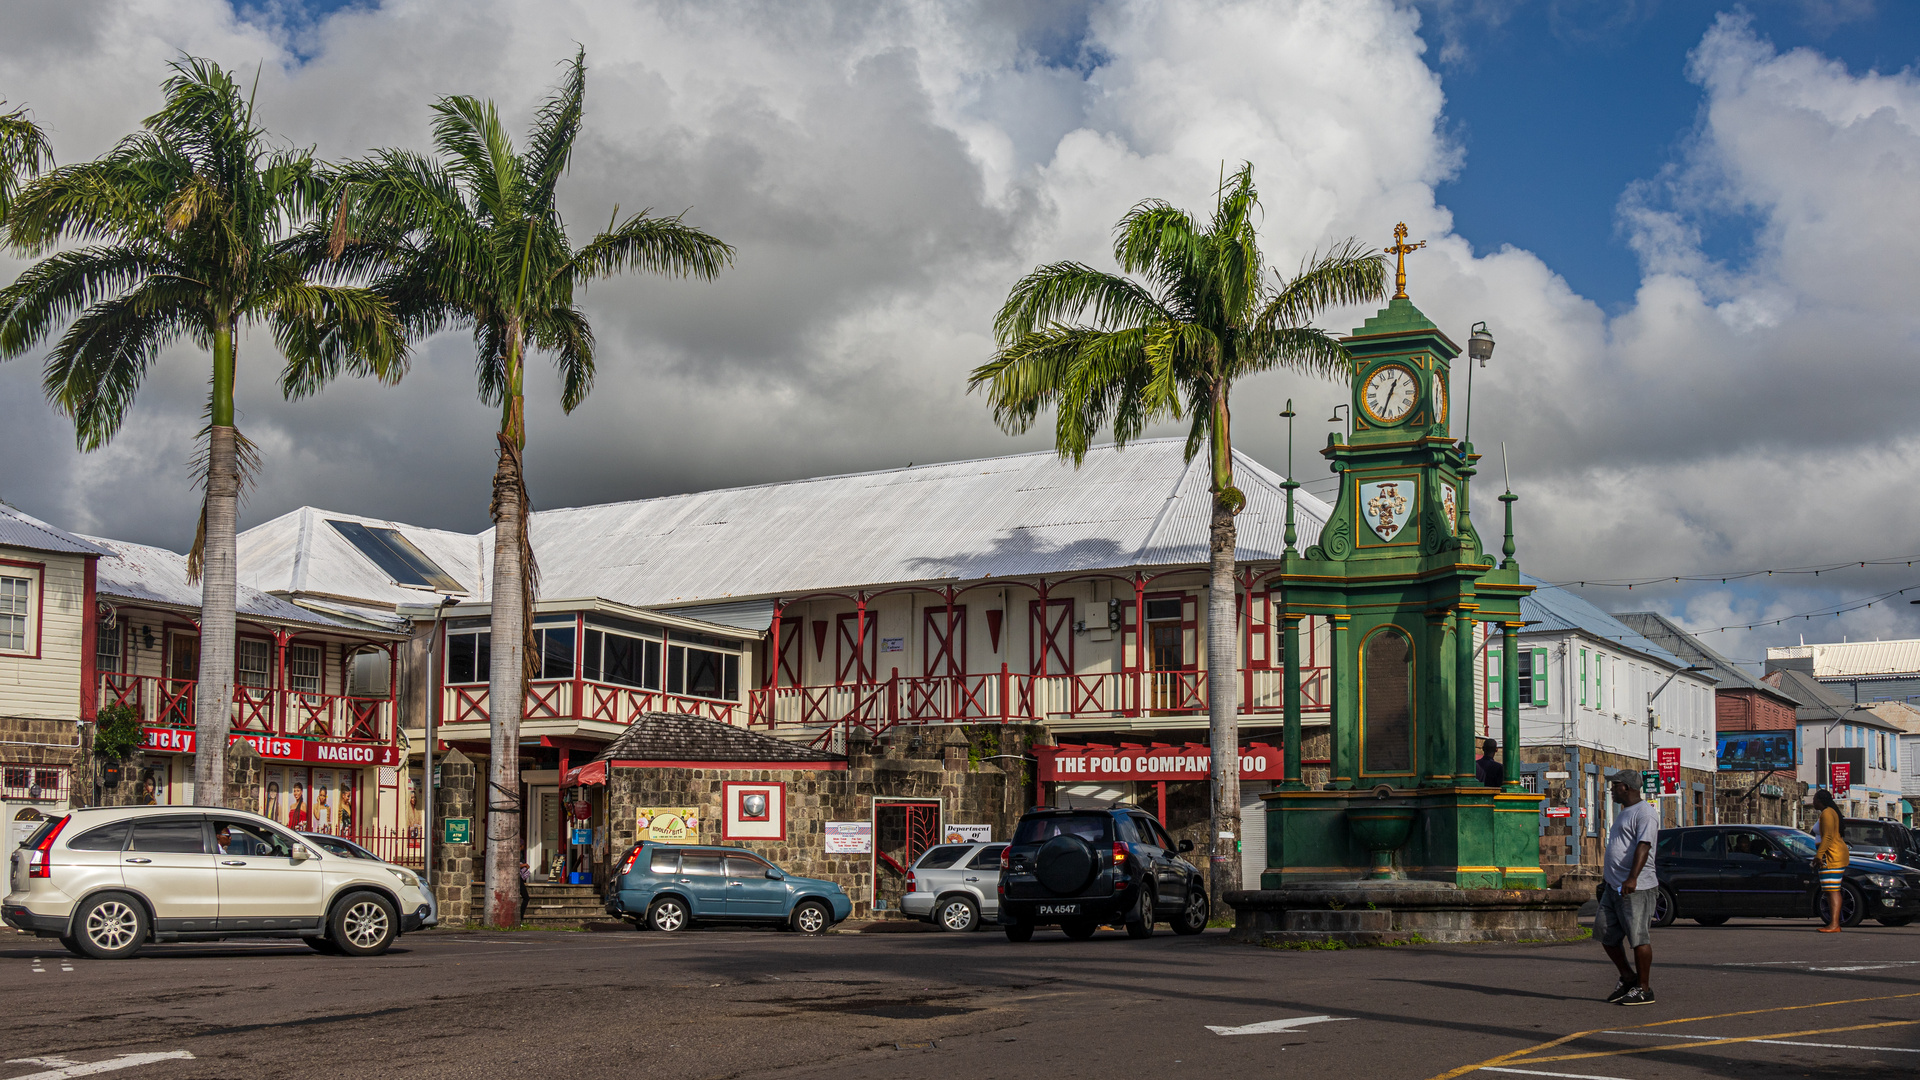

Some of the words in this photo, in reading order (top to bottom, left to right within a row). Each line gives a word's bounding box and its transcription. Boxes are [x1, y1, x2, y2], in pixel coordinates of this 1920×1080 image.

[138, 729, 192, 753] ucky
[318, 745, 374, 762] NAGICO
[1055, 757, 1086, 773] THE
[1090, 757, 1132, 773] POLO
[1136, 756, 1211, 773] COMPAN
[1040, 906, 1054, 914] PA
[1054, 905, 1076, 914] 4547
